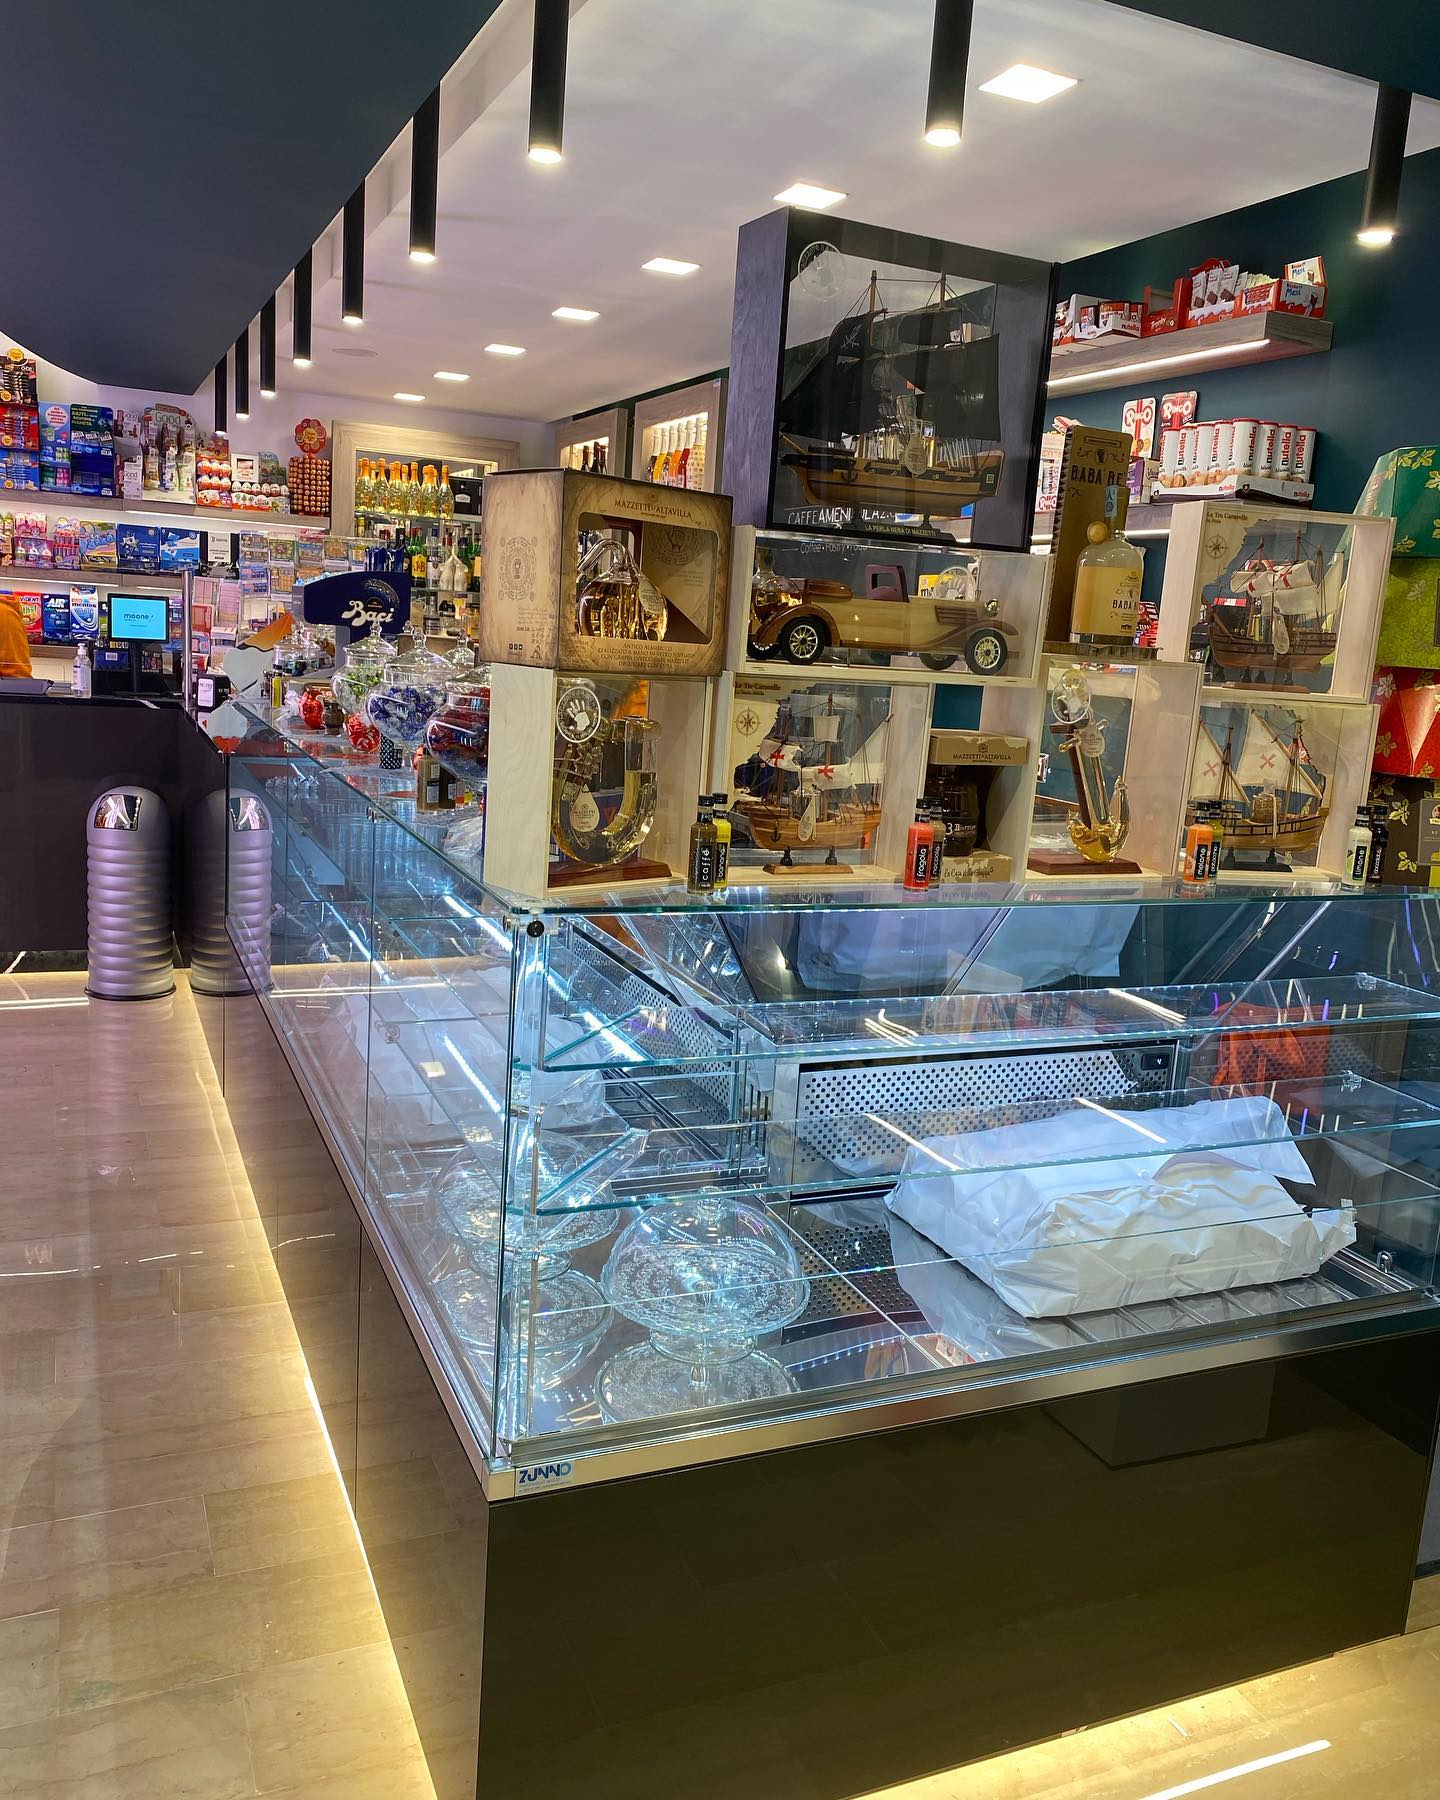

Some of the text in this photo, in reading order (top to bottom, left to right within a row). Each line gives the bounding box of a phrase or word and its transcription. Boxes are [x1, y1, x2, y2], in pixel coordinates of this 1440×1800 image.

[155, 411, 181, 425] Good
[1178, 432, 1187, 466] nutella
[1212, 428, 1220, 462] nutella
[1266, 429, 1276, 464] nutella
[1282, 432, 1292, 466] nutella
[1295, 434, 1306, 469] nutella
[800, 543, 821, 554] Coffee
[47, 598, 65, 608] AIR
[341, 600, 395, 627] Baci
[953, 753, 980, 761] MAZZETTI
[717, 844, 726, 878] banana
[916, 847, 927, 878] fragola
[1197, 846, 1207, 876] melone
[1354, 848, 1365, 876] limone
[518, 1462, 573, 1484] ZUNNO
